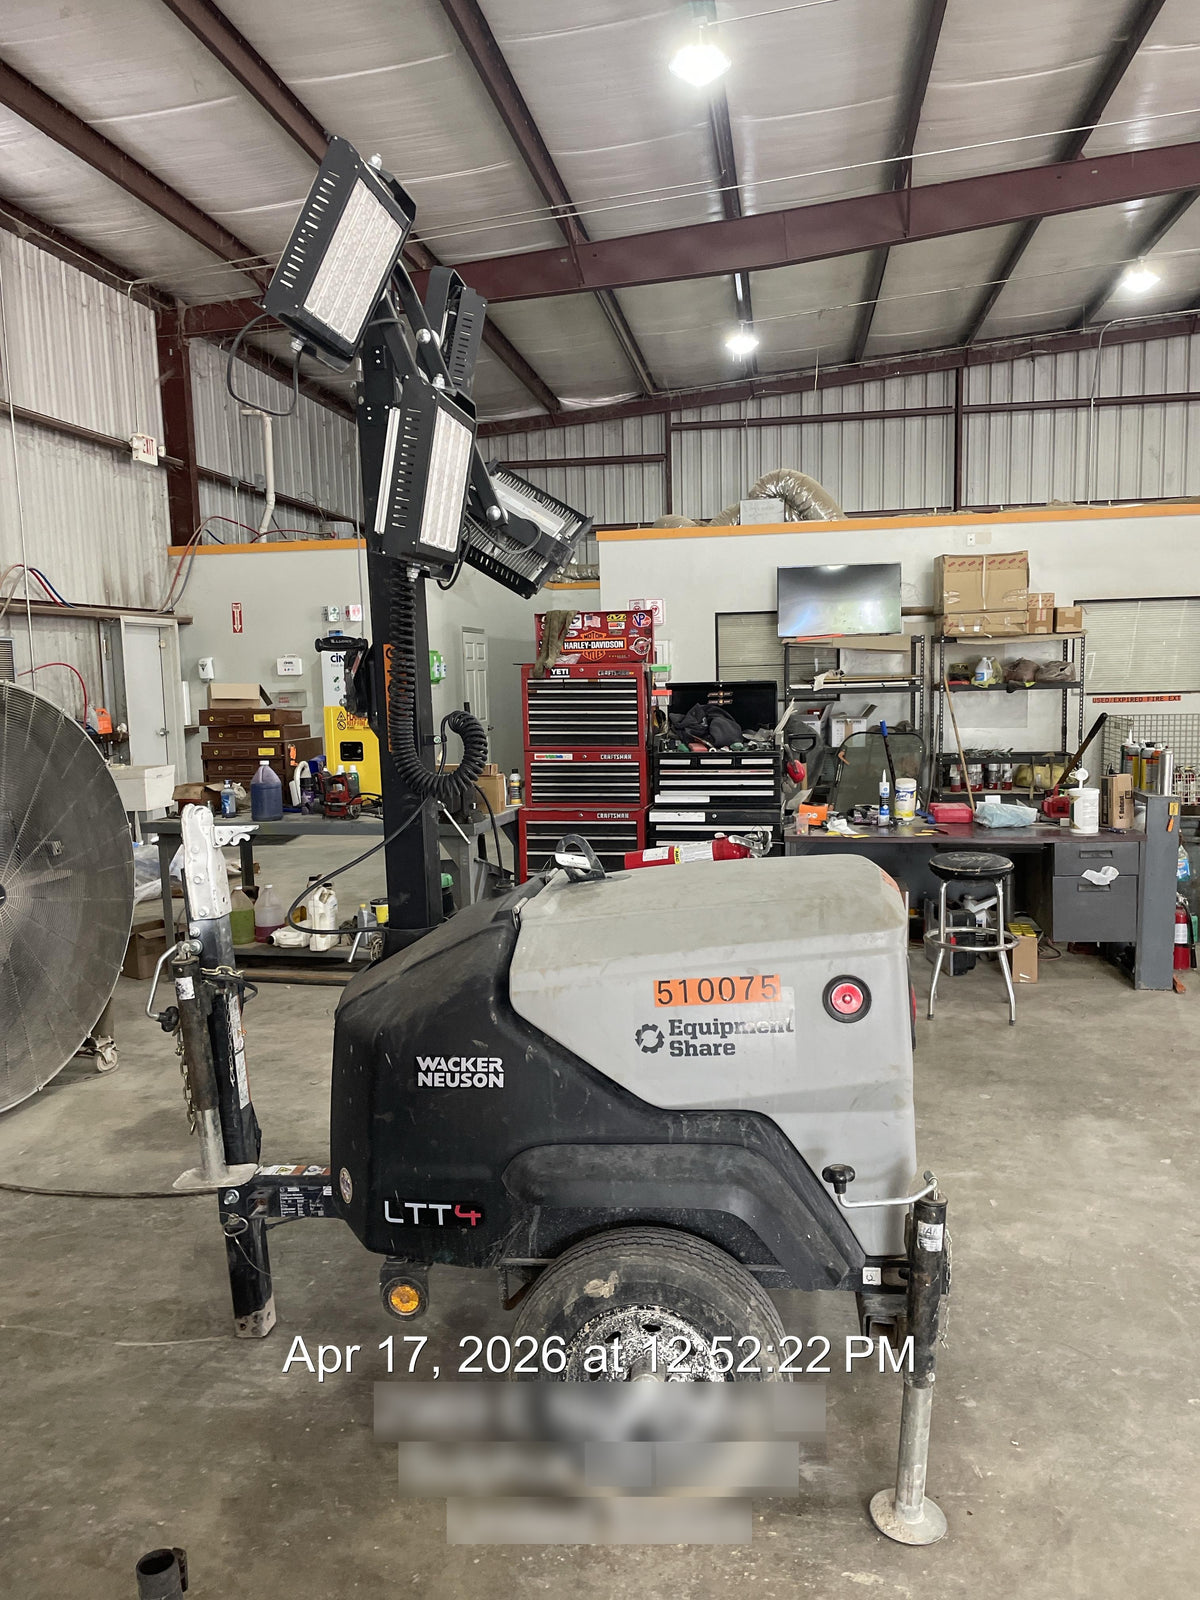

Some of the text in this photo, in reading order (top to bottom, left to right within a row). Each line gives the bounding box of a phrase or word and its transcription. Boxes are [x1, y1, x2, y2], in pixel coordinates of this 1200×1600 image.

[564, 640, 624, 650] HARLEY-DAVIDSON
[658, 975, 777, 1005] 510075
[669, 1040, 736, 1057] Share
[416, 1056, 504, 1072] WACKER
[417, 1072, 504, 1088] NEUSON
[384, 1200, 482, 1226] LTT4
